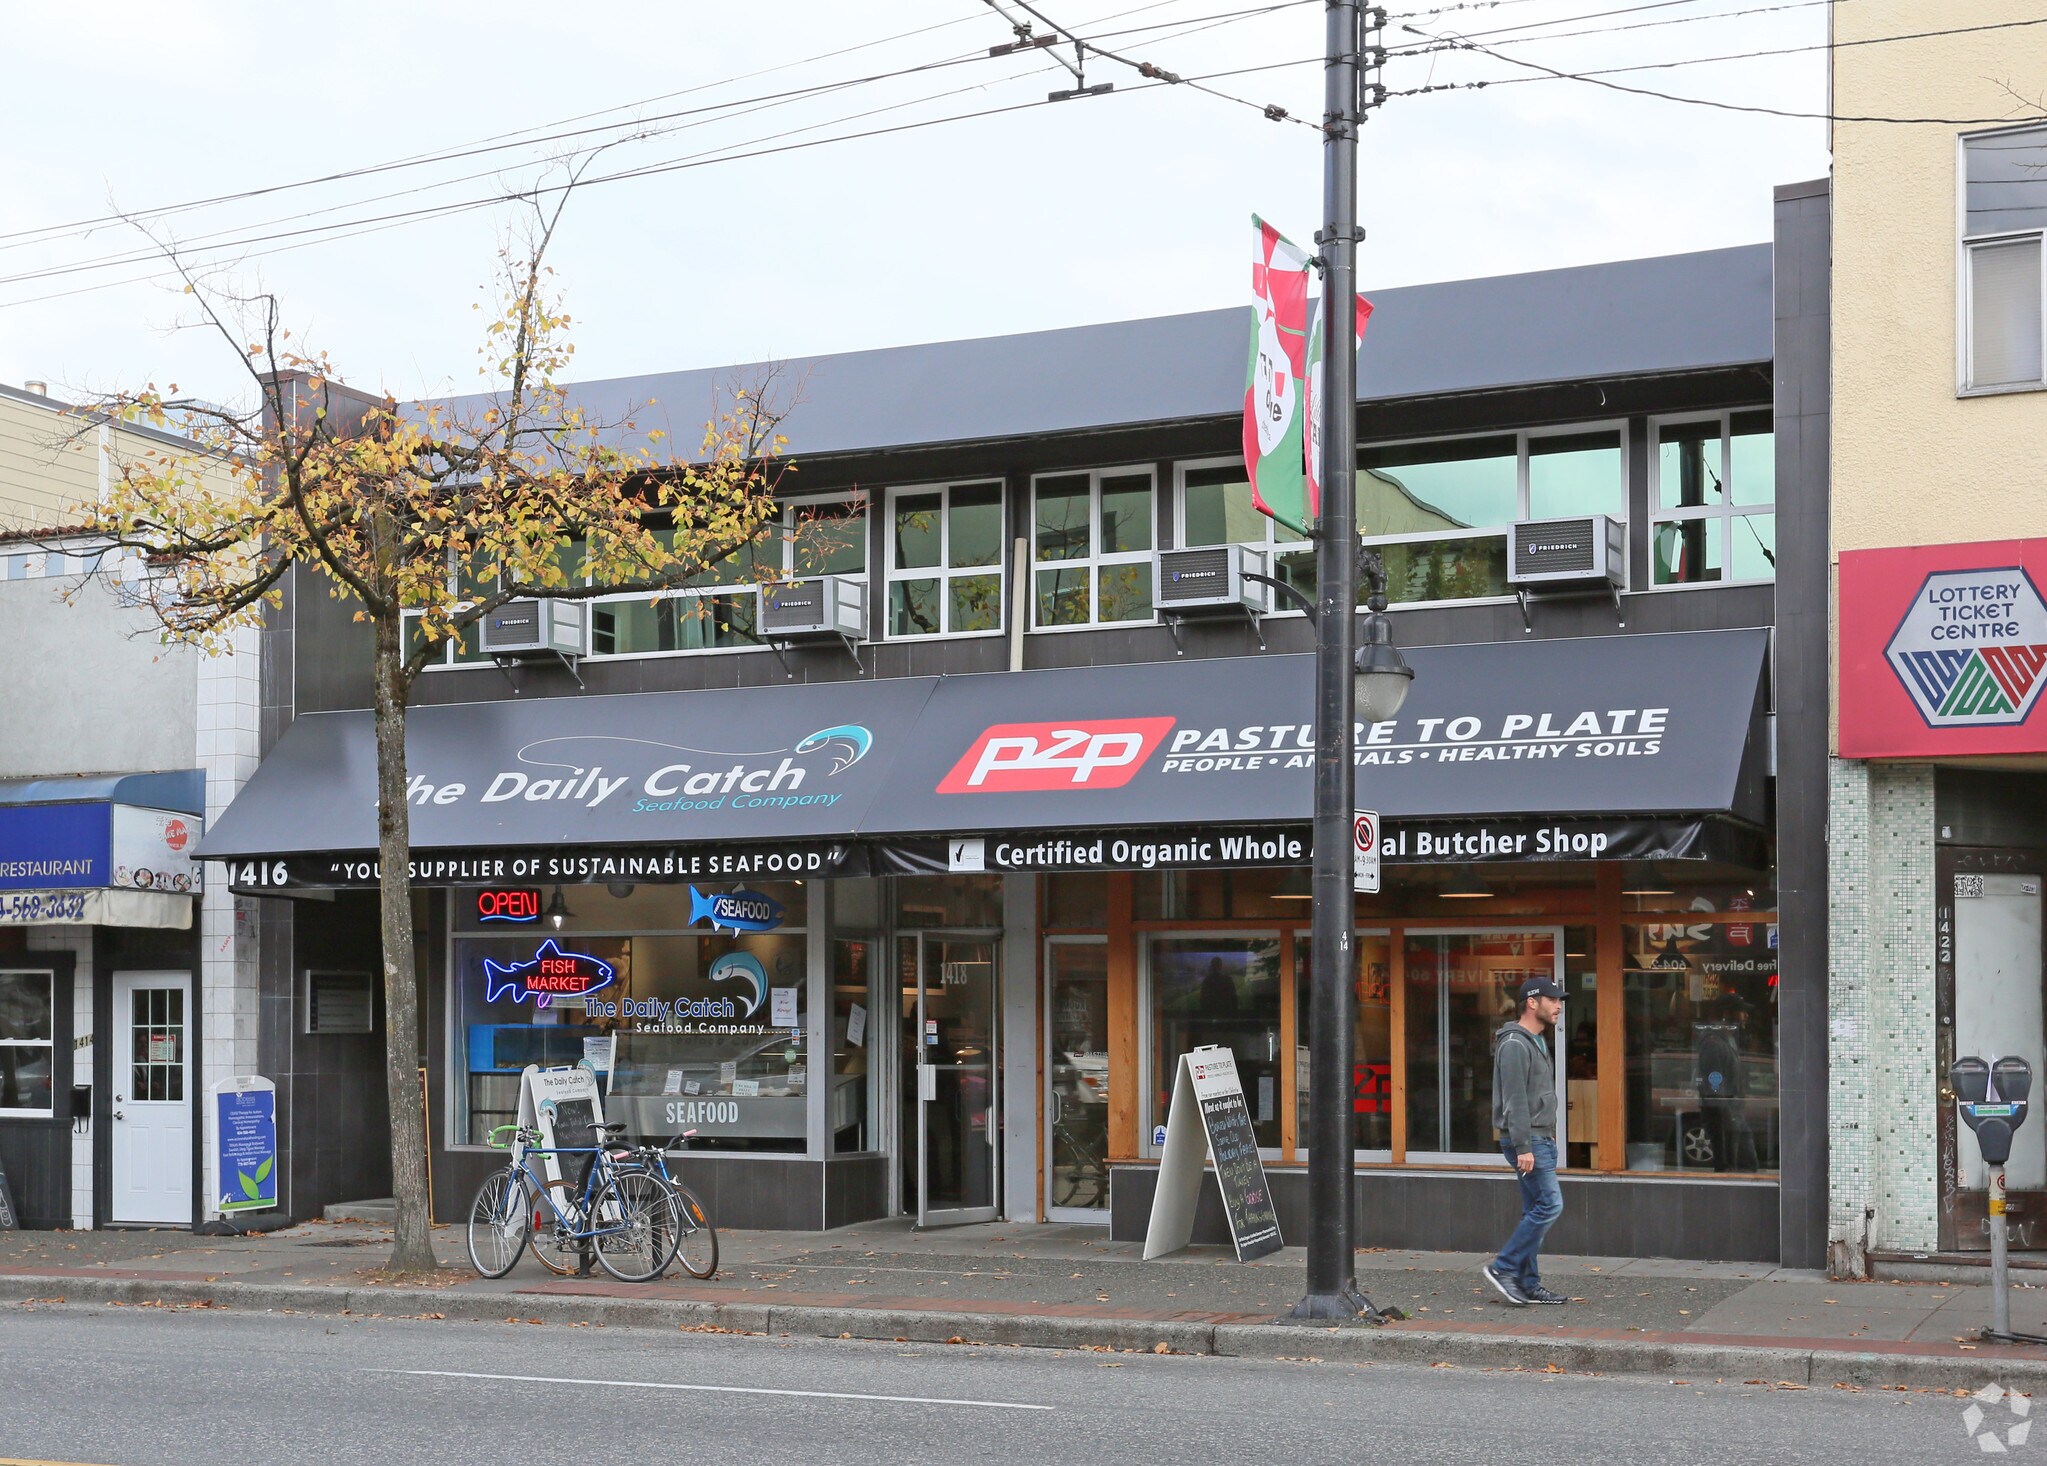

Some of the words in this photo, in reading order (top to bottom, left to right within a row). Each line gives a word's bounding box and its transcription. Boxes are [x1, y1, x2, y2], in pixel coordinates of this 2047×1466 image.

[1538, 543, 1578, 551] FRIEDRICH
[1181, 571, 1216, 579] FRIEDRICH
[1929, 583, 2021, 604] LOTTERY
[1938, 602, 2014, 621] TICKET
[1931, 621, 2020, 641] CENTRE
[1416, 716, 1481, 742] TO
[1501, 708, 1669, 738] PLATE
[1162, 756, 1263, 773] PEOPLE
[1438, 744, 1568, 763] HEALTHY
[1575, 740, 1661, 757] SOILS
[480, 767, 629, 807] Daily
[643, 757, 806, 797] Catch
[632, 795, 726, 813] Seafood
[731, 792, 843, 811] Company
[994, 839, 1103, 866] Certified
[1112, 838, 1202, 868] Organic
[1219, 834, 1301, 859] Whole
[1417, 829, 1526, 856] Butcher
[1536, 826, 1607, 857] Shop
[0, 859, 93, 877] RESTAURANT
[229, 861, 289, 886] 1416
[408, 859, 504, 879] SUPPLIER
[512, 858, 540, 876] OF
[549, 856, 700, 875] SUSTAINABLE
[478, 892, 537, 915] OPEN
[721, 898, 770, 919] SEAFOOD
[1340, 941, 1349, 951] 14
[1341, 931, 1347, 941] 4
[541, 960, 576, 974] FISH
[941, 962, 967, 985] 1418
[526, 976, 590, 991] MARKET
[584, 997, 617, 1018] The
[622, 997, 670, 1021] Daily
[674, 996, 735, 1018] Catch
[636, 1022, 692, 1033] Seafood
[699, 1022, 765, 1035] Company
[543, 1078, 553, 1087] The
[554, 1077, 567, 1087] Daily
[568, 1076, 584, 1085] Catch
[666, 1101, 739, 1124] SEAFOOD
